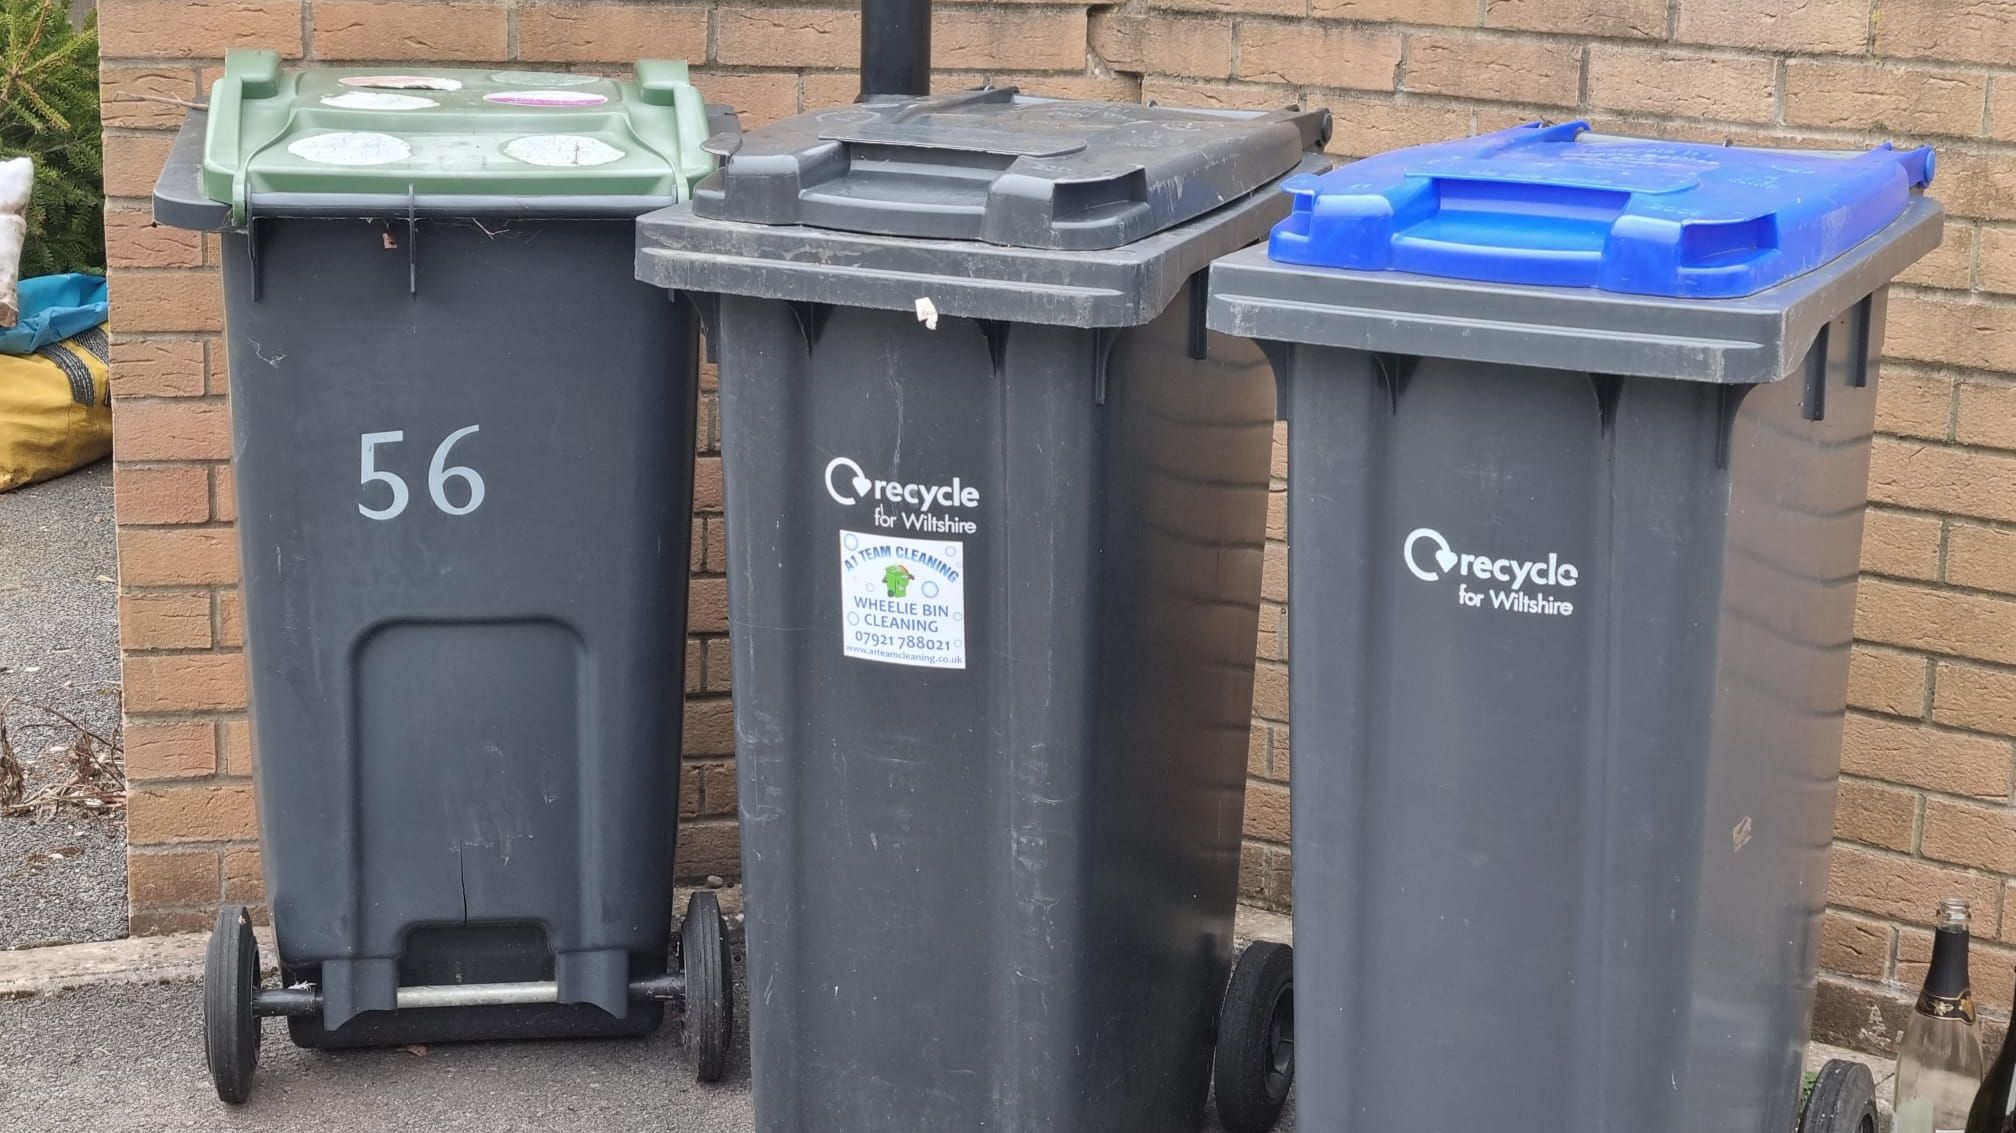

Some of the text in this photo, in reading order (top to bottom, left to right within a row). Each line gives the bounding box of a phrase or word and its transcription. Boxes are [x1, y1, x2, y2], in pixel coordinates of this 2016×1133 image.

[358, 424, 486, 520] 56
[874, 477, 980, 511] recycle
[874, 503, 977, 534] for Wiltshire
[844, 545, 960, 583] A1 TEAM CLEANING
[1460, 553, 1579, 590] recycle
[854, 595, 949, 618] WHEELIE BIN
[1458, 584, 1574, 616] for Wiltshire
[864, 613, 939, 633] CLEANING
[855, 630, 951, 651] 07921 788021
